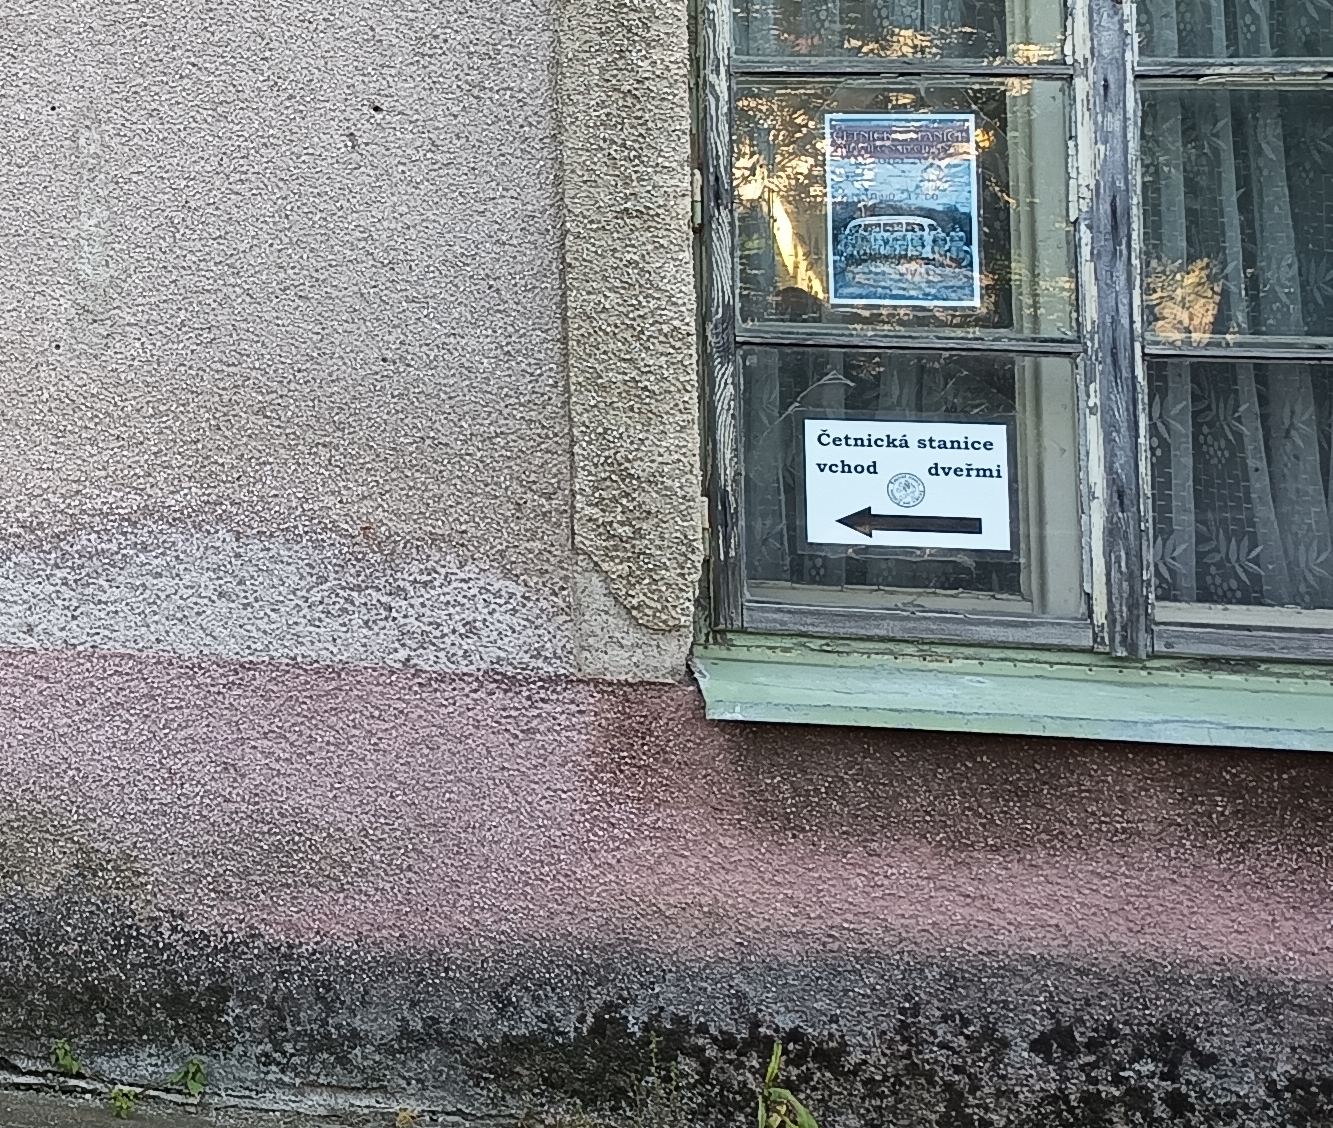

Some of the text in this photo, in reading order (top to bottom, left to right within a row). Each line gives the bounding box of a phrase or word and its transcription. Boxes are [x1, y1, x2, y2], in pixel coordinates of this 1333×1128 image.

[817, 429, 994, 451] Četnická stanice
[816, 460, 1002, 478] vchod dveřmi
